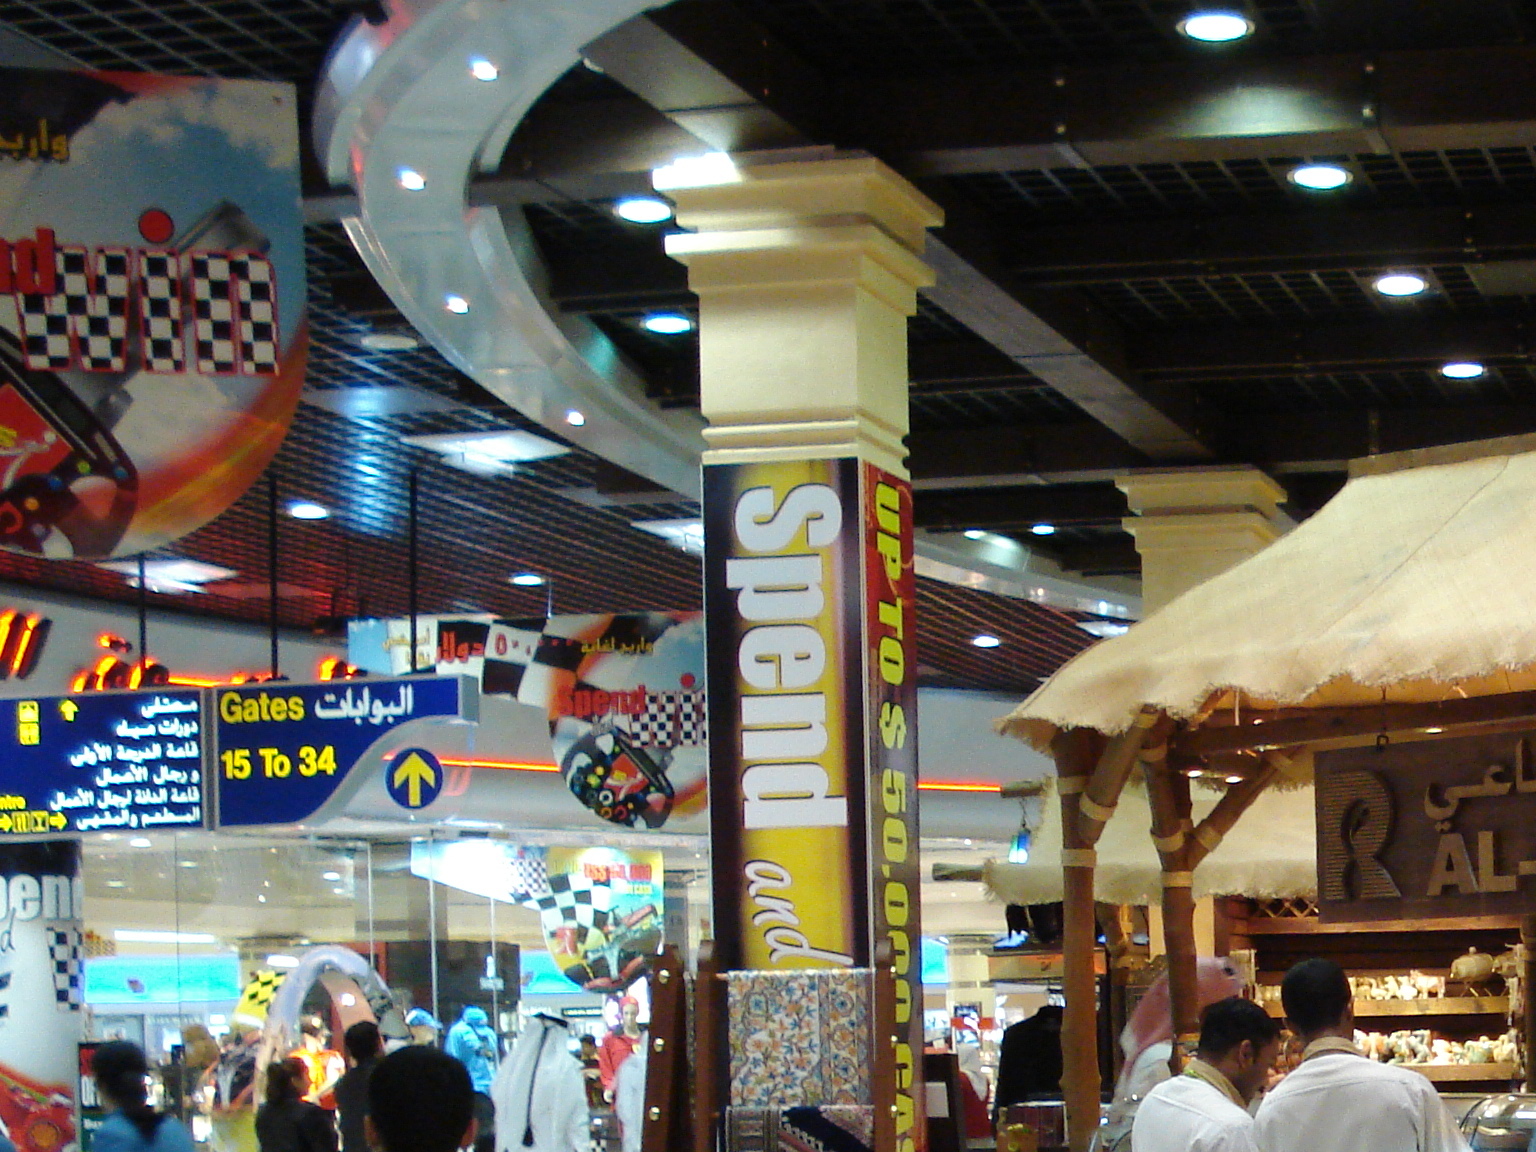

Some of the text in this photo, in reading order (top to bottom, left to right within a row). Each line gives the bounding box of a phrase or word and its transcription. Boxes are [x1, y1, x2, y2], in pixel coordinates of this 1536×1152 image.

[15, 208, 281, 375] Win
[875, 482, 902, 582] UP
[726, 483, 848, 829] Spend
[878, 600, 905, 687] TO
[220, 691, 304, 723] Gates
[314, 684, 413, 725] البوابات
[556, 684, 646, 718] Spend
[628, 673, 706, 748] Wi
[878, 702, 907, 750] $
[221, 745, 337, 779] 15 To 34
[743, 859, 855, 966] and
[881, 767, 912, 1024] 50,000
